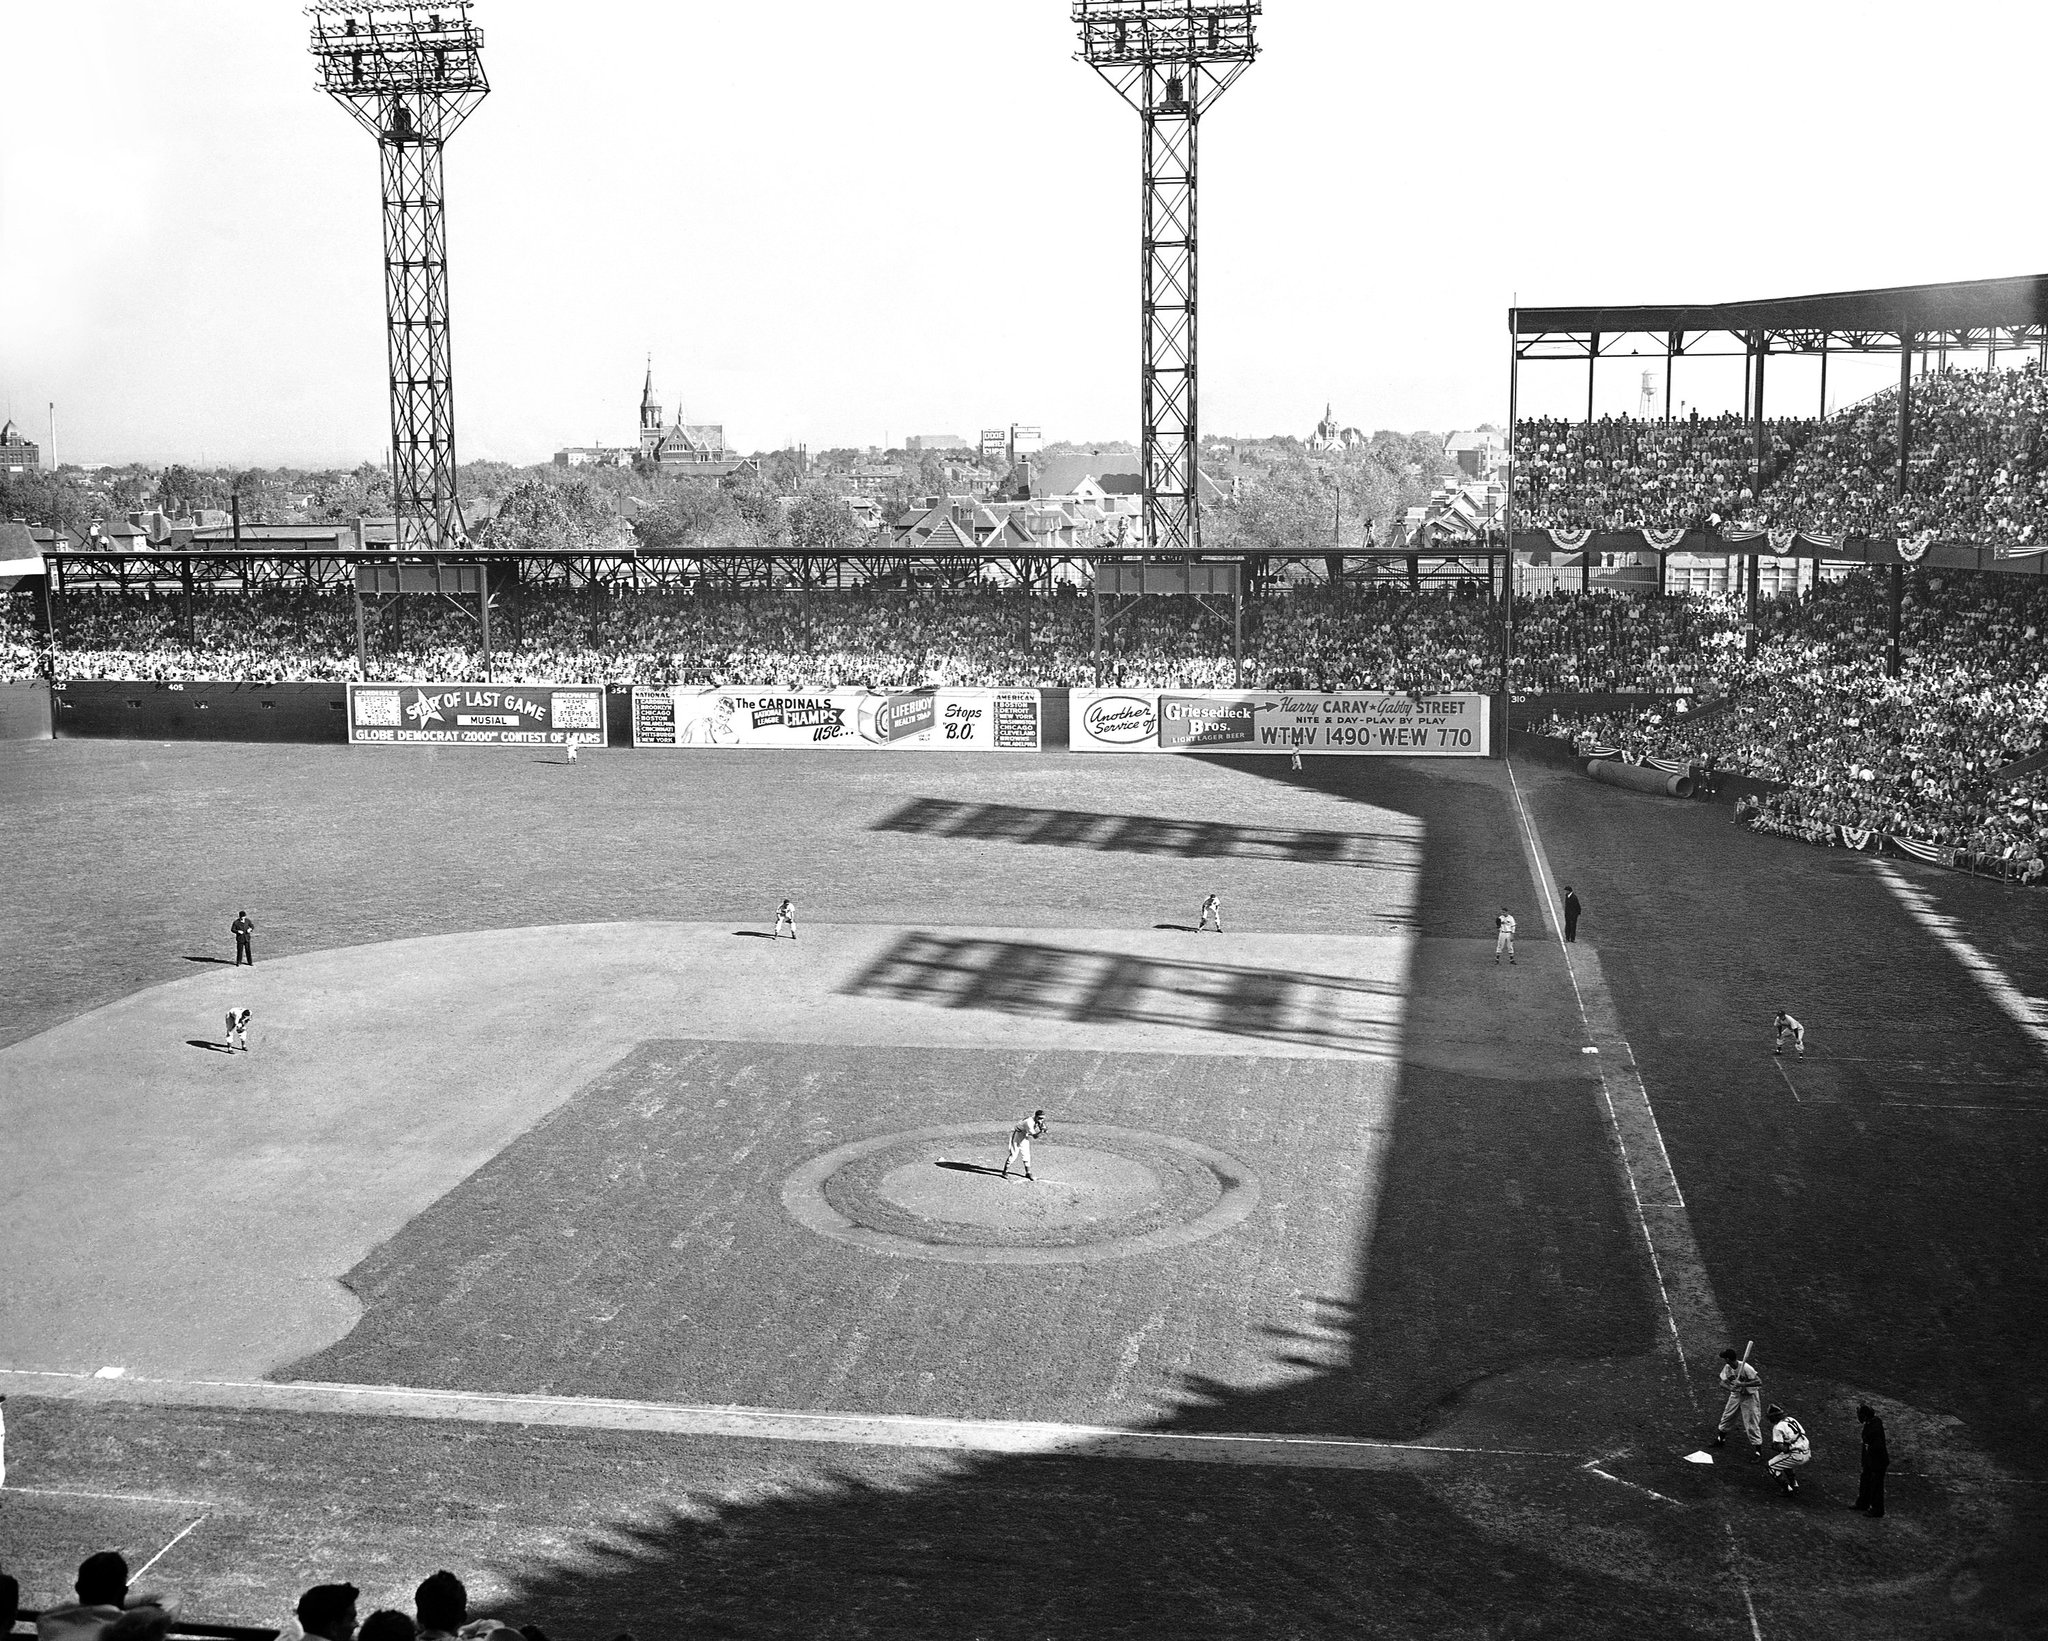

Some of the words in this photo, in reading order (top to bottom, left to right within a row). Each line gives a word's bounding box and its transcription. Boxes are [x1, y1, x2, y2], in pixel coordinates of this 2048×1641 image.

[168, 683, 184, 691] 405
[610, 686, 627, 694] 354
[405, 696, 442, 721] STAR
[443, 692, 461, 708] OF
[465, 691, 501, 707] LAST
[504, 695, 546, 721] GAME
[735, 698, 756, 709] The
[758, 698, 832, 710] CARDINALS
[1279, 696, 1319, 715] Harry
[1323, 700, 1370, 714] CARAY
[1377, 697, 1413, 717] Gabby
[1415, 701, 1466, 714] STREET
[1511, 695, 1526, 703] 310
[891, 696, 934, 720] LIFEBUOY
[945, 703, 982, 722] Stops
[1090, 706, 1151, 723] Another
[1164, 702, 1252, 721] Griesedieck
[470, 716, 507, 725] MUSIAL
[757, 716, 781, 726] LEAGUE
[786, 709, 838, 726] CHAMPS
[894, 715, 916, 728] HEALTH
[916, 711, 932, 721] SOAP
[1094, 719, 1139, 735] Service
[1143, 714, 1157, 735] of
[1400, 717, 1414, 725] BY
[1419, 717, 1446, 725] PLAY
[355, 729, 394, 740] GLOBE
[397, 730, 459, 741] DEMOCRAT
[500, 731, 545, 742] CONTEST
[549, 732, 564, 743] OF
[1188, 719, 1231, 736] Bros.
[1172, 735, 1196, 744] LIGHT
[1197, 733, 1223, 742] LAGER
[1225, 731, 1245, 739] BEER
[1326, 727, 1370, 746] 1490
[1437, 728, 1472, 747] 770
